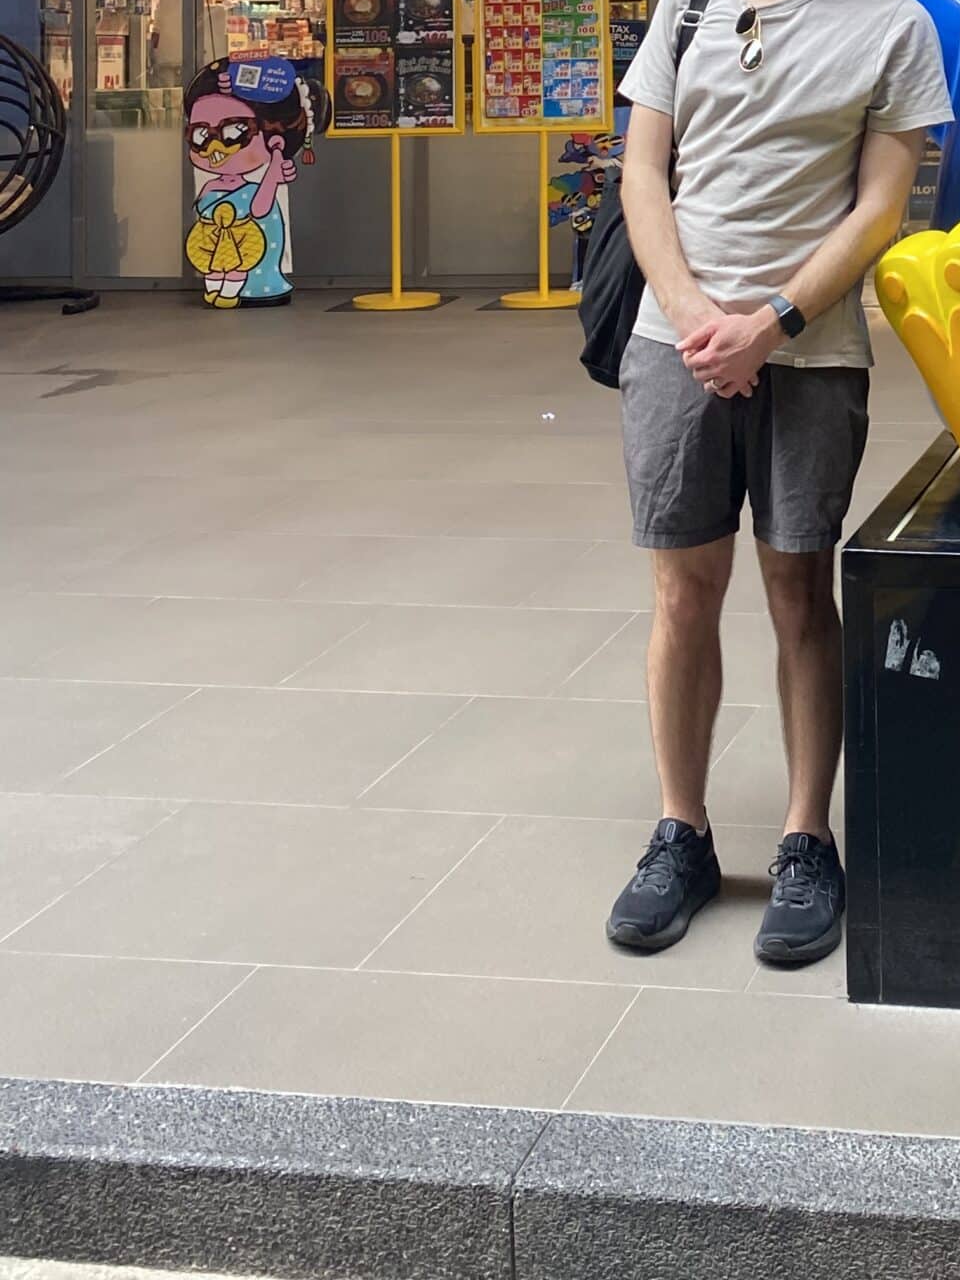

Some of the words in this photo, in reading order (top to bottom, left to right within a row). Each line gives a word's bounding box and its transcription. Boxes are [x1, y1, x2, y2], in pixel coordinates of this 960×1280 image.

[578, 1, 593, 11] 120
[579, 26, 595, 35] 100
[609, 24, 630, 34] TAX
[610, 33, 638, 42] EFUND
